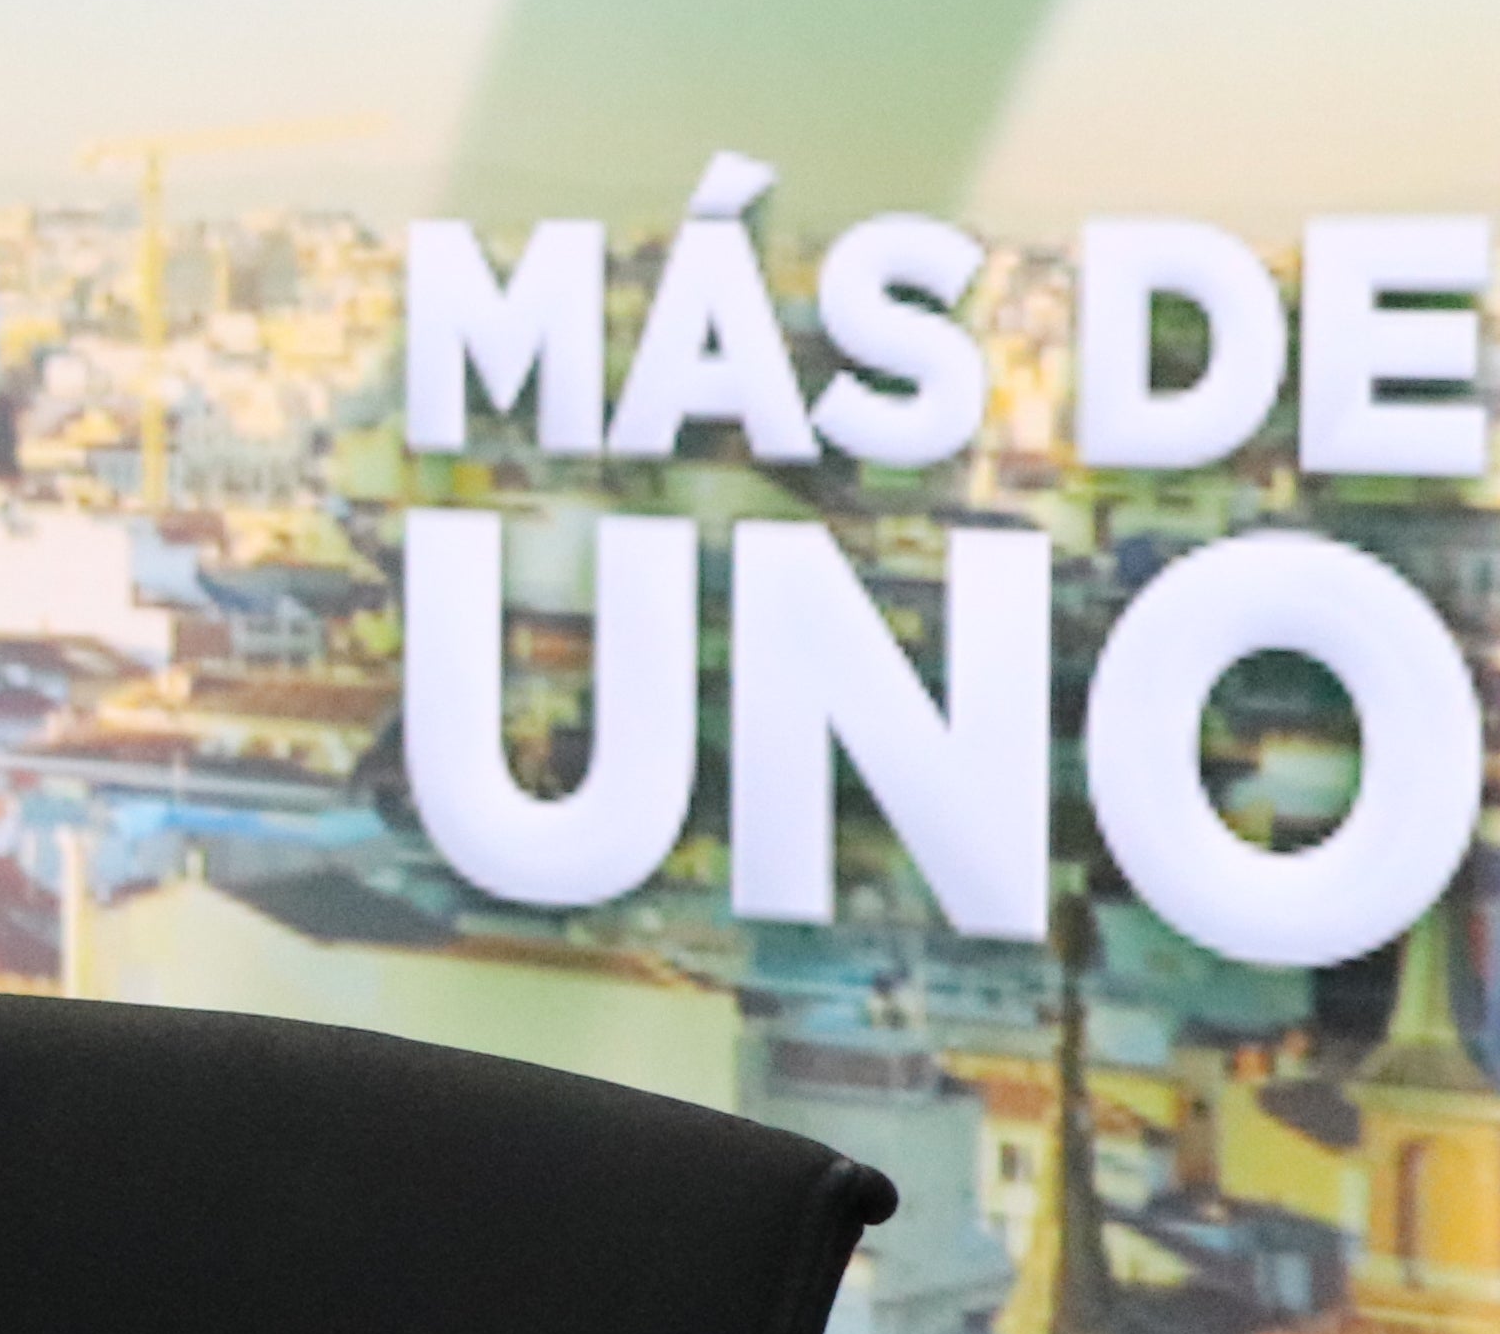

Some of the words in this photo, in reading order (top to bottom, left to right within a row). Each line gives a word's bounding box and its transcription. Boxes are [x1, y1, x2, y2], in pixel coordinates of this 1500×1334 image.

[404, 151, 987, 468] MÁS
[1080, 215, 1492, 476] DE
[404, 508, 1483, 970] UNO
